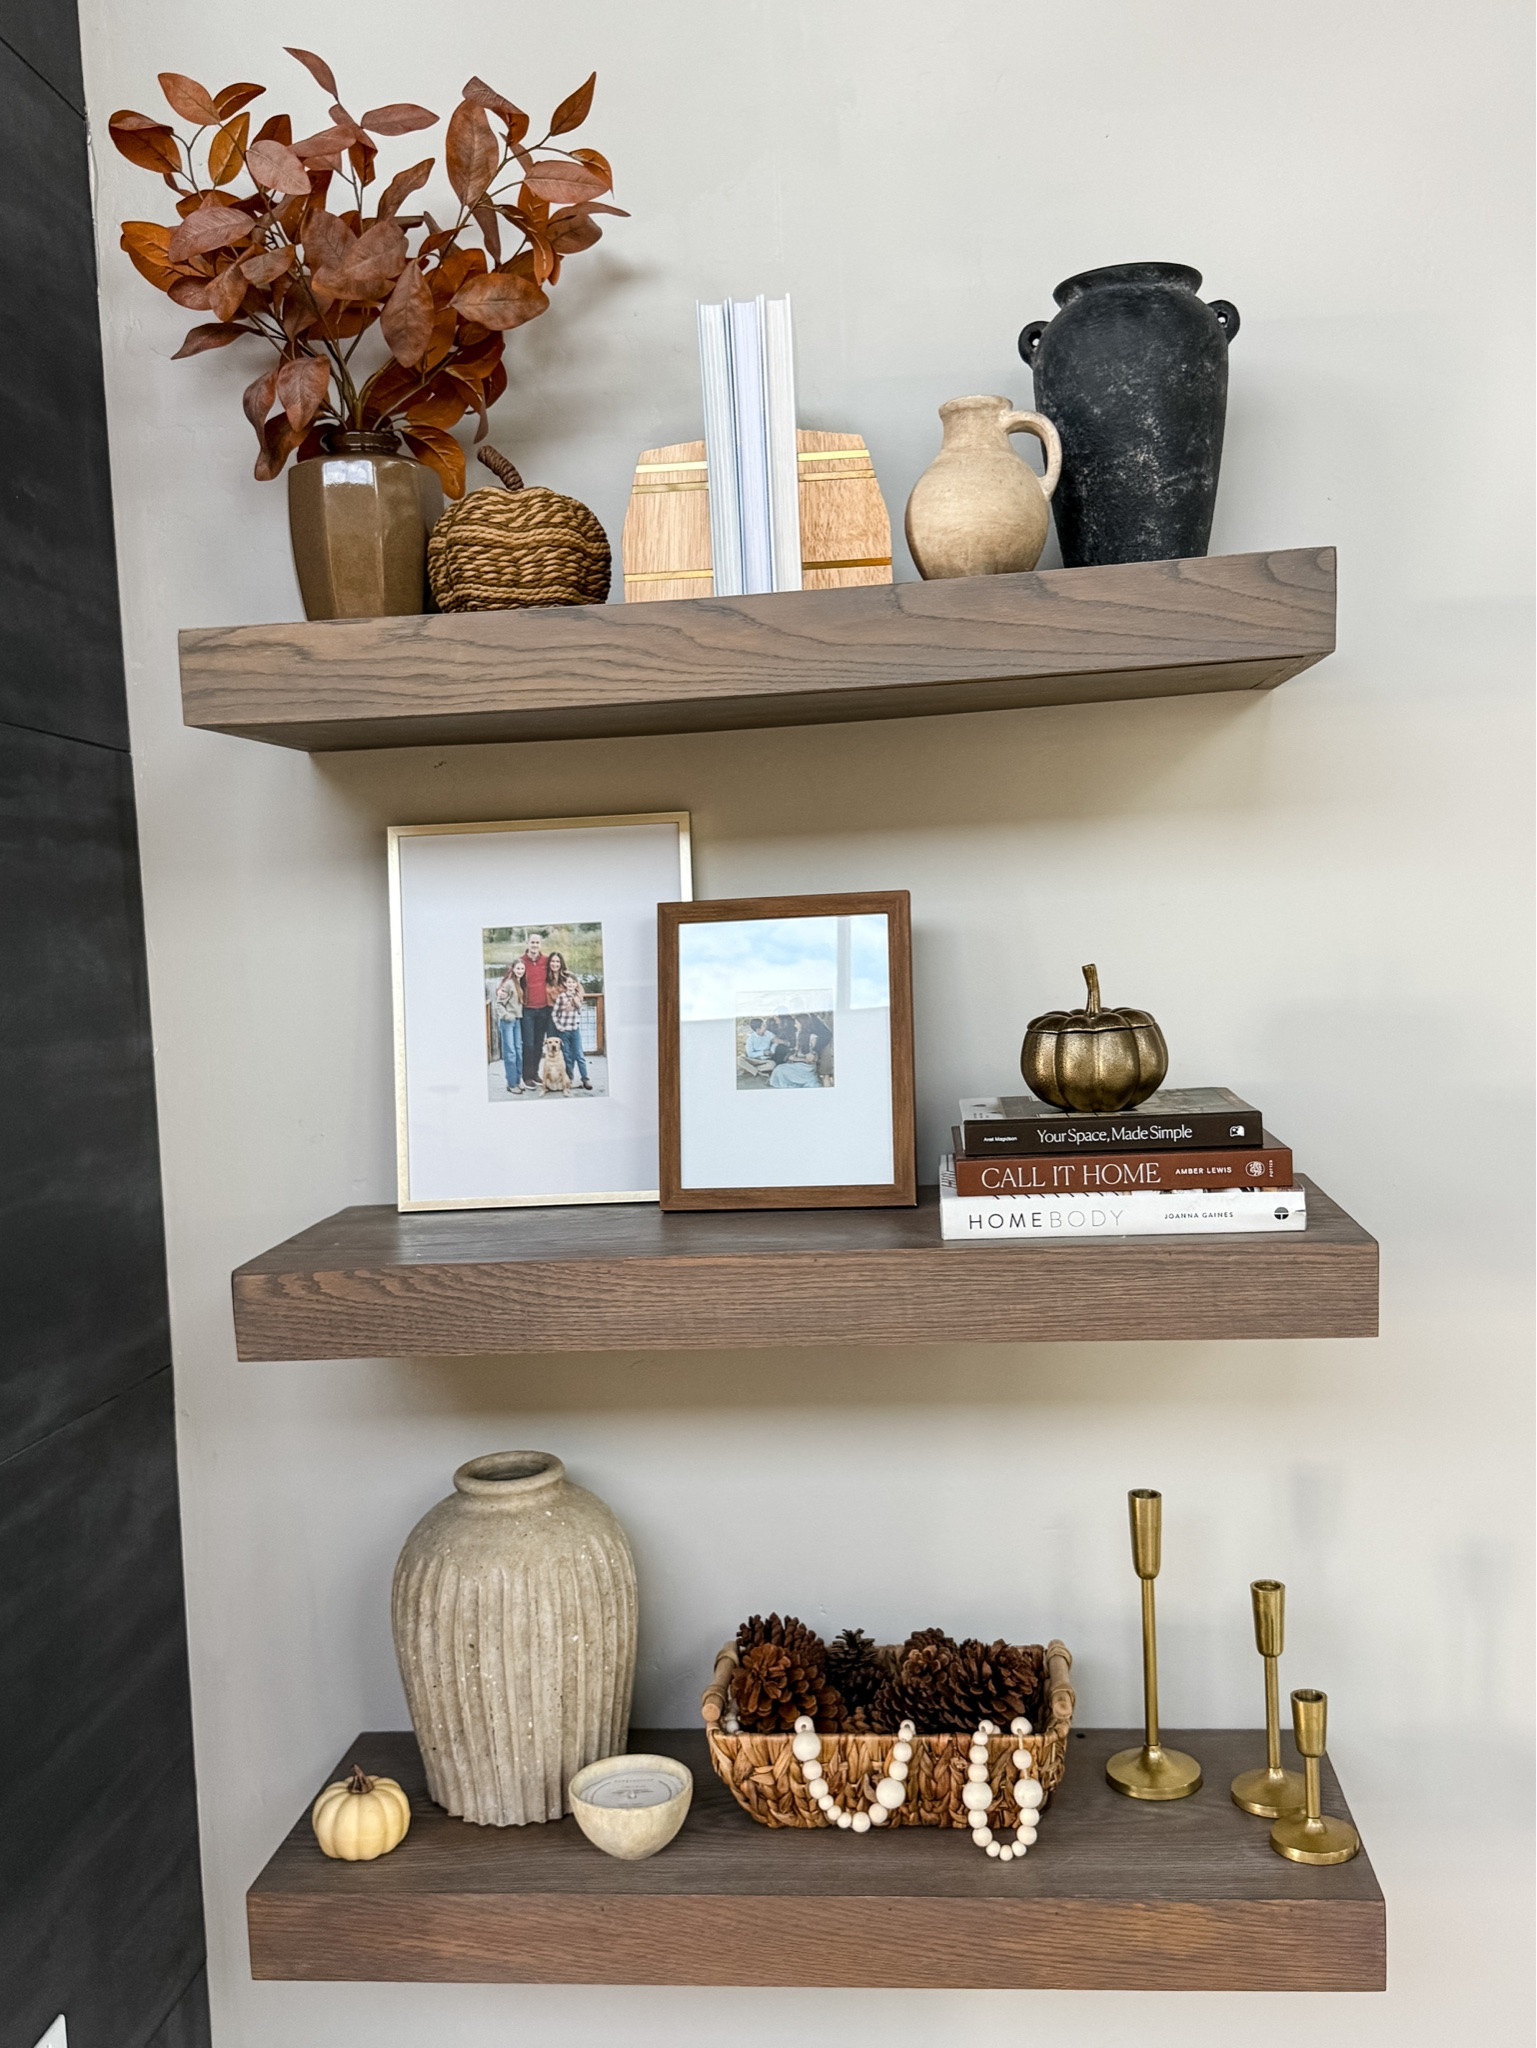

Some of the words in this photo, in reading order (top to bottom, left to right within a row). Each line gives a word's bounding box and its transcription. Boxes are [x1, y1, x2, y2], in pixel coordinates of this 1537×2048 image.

[1037, 1129, 1067, 1143] Your
[1068, 1128, 1111, 1146] Space,
[1112, 1126, 1149, 1141] Made
[1150, 1123, 1193, 1143] Simple
[981, 1166, 1046, 1189] CALL
[1052, 1165, 1076, 1187] IT
[1082, 1162, 1162, 1186] HOME
[1175, 1167, 1204, 1175] AMBER
[1206, 1166, 1232, 1174] LEWIS
[968, 1209, 1124, 1231] HOMEBODY
[1164, 1212, 1199, 1220] JOANNA
[1201, 1211, 1234, 1219] GAINES
